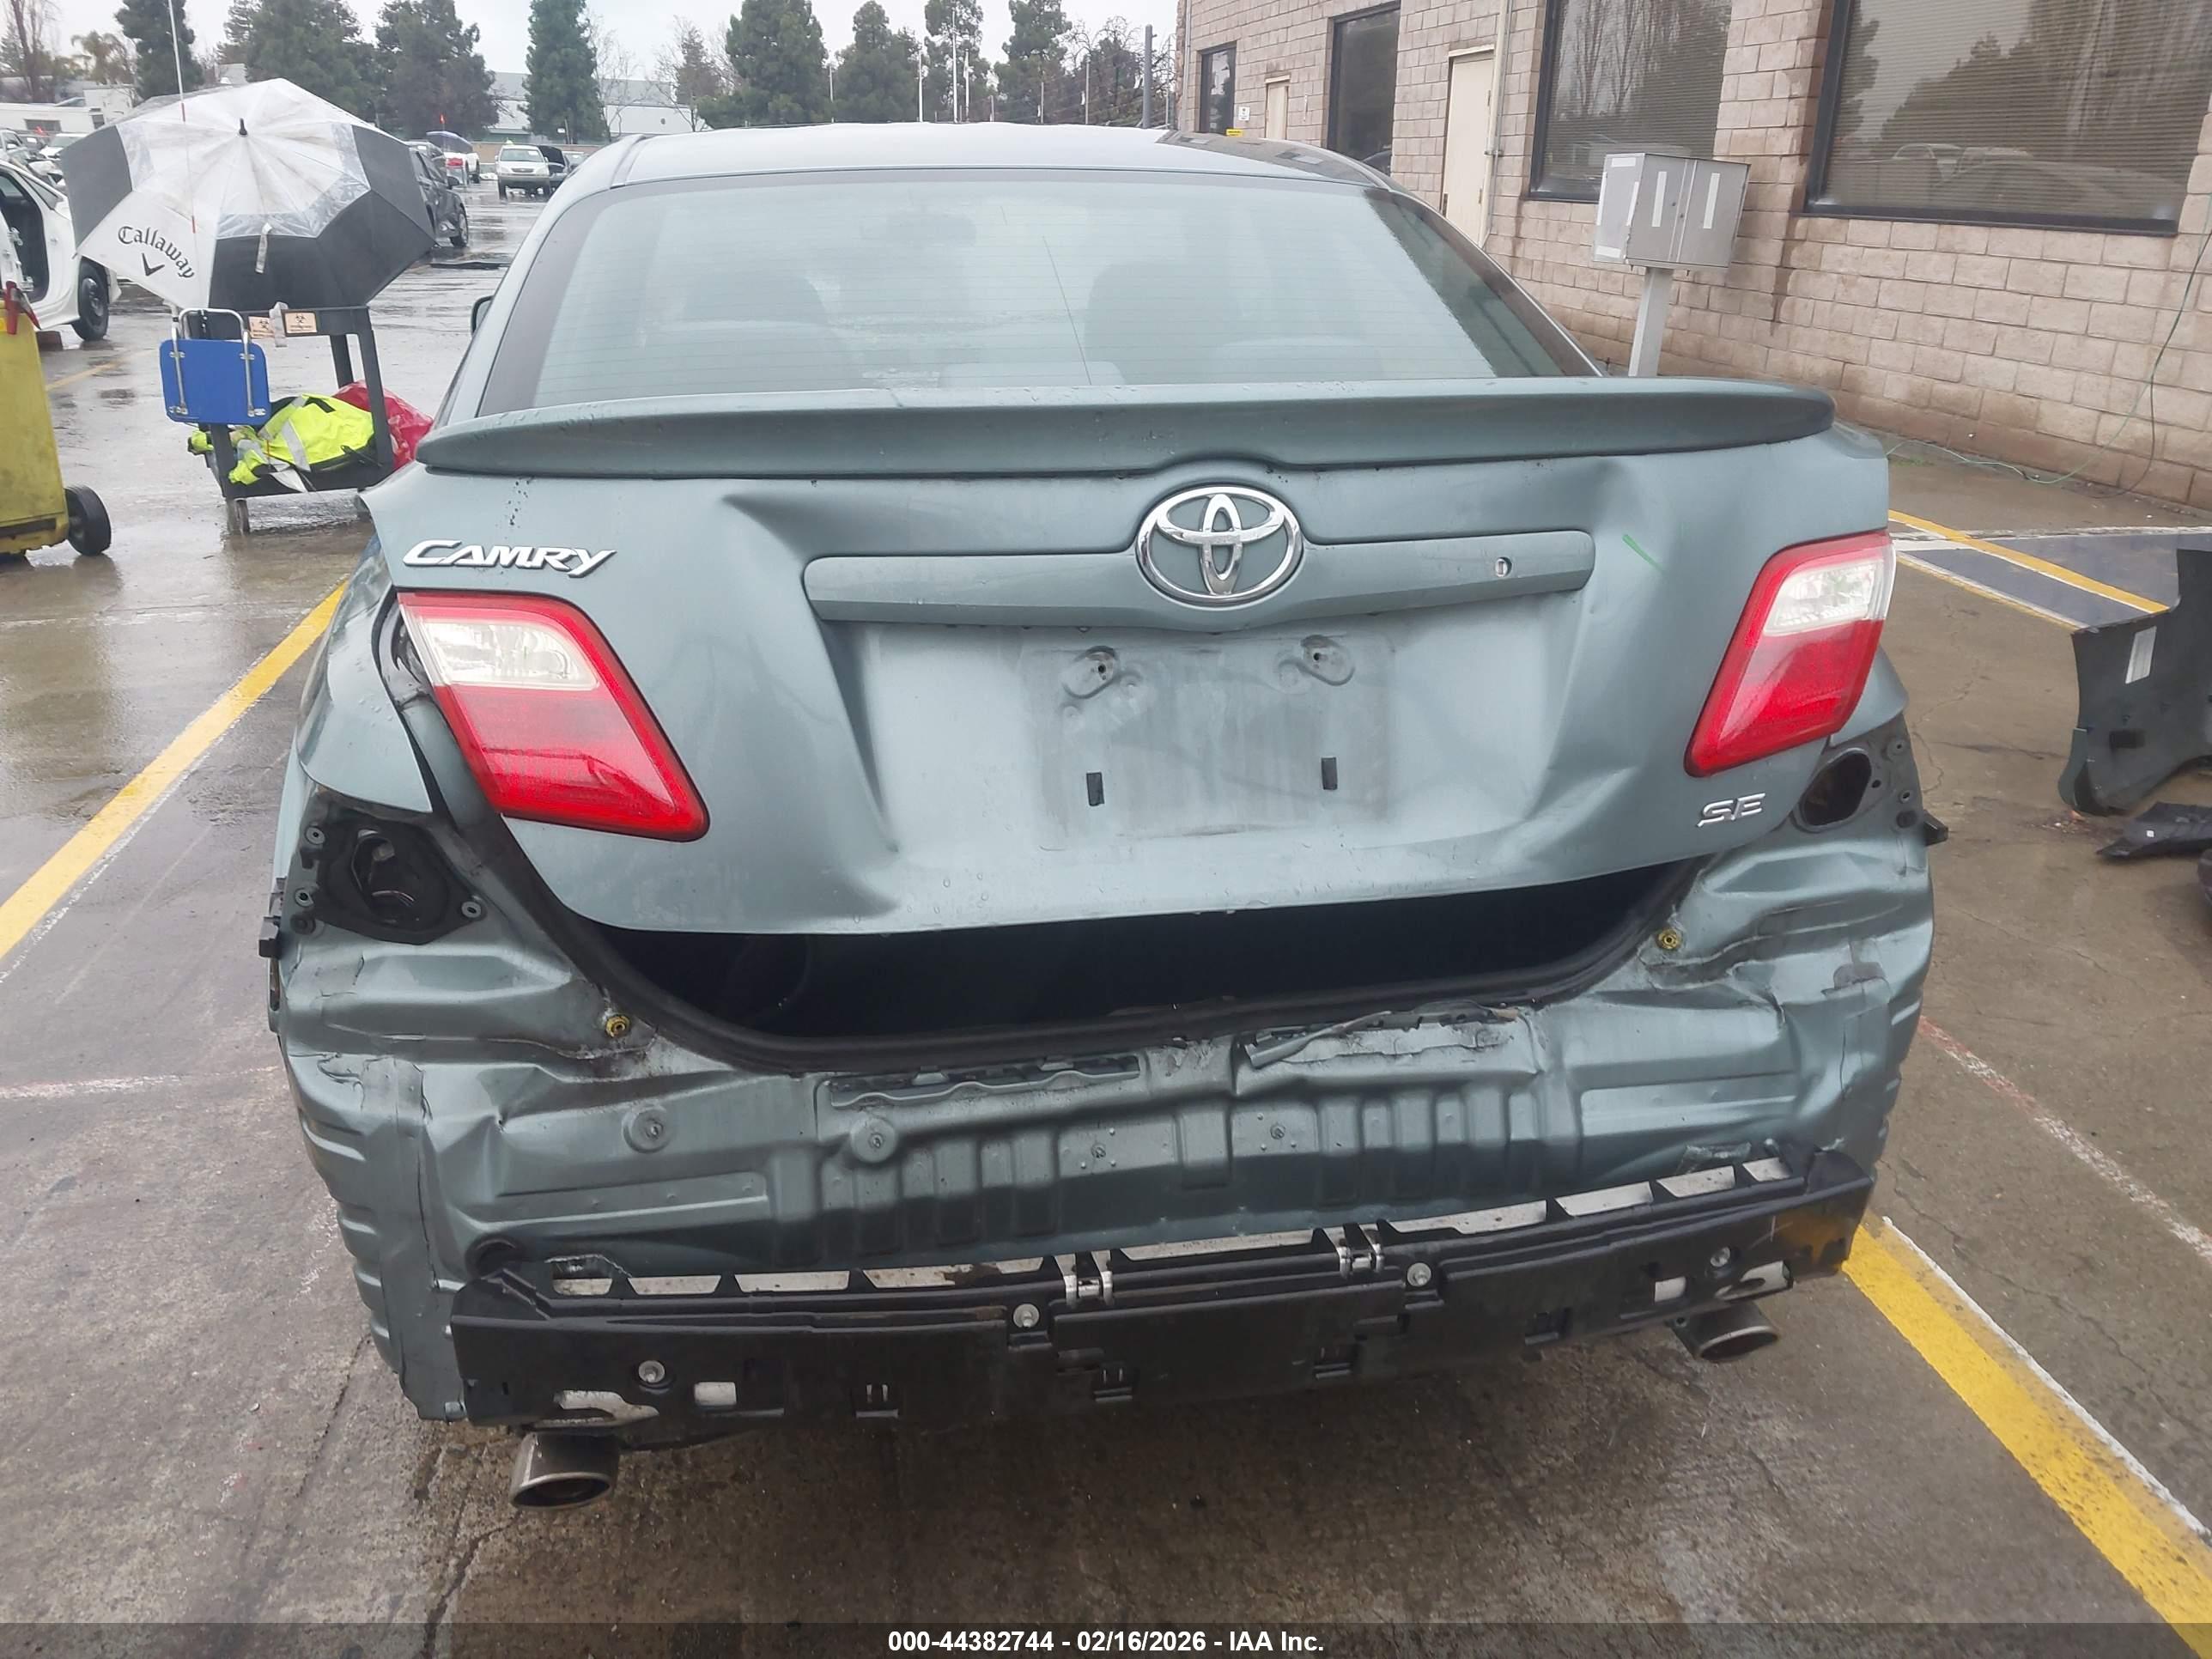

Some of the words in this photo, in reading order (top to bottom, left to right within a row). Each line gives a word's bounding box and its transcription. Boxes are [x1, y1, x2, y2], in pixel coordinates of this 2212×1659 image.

[118, 226, 195, 278] Callaway
[403, 539, 617, 578] CAMRY
[1697, 793, 1766, 827] SE
